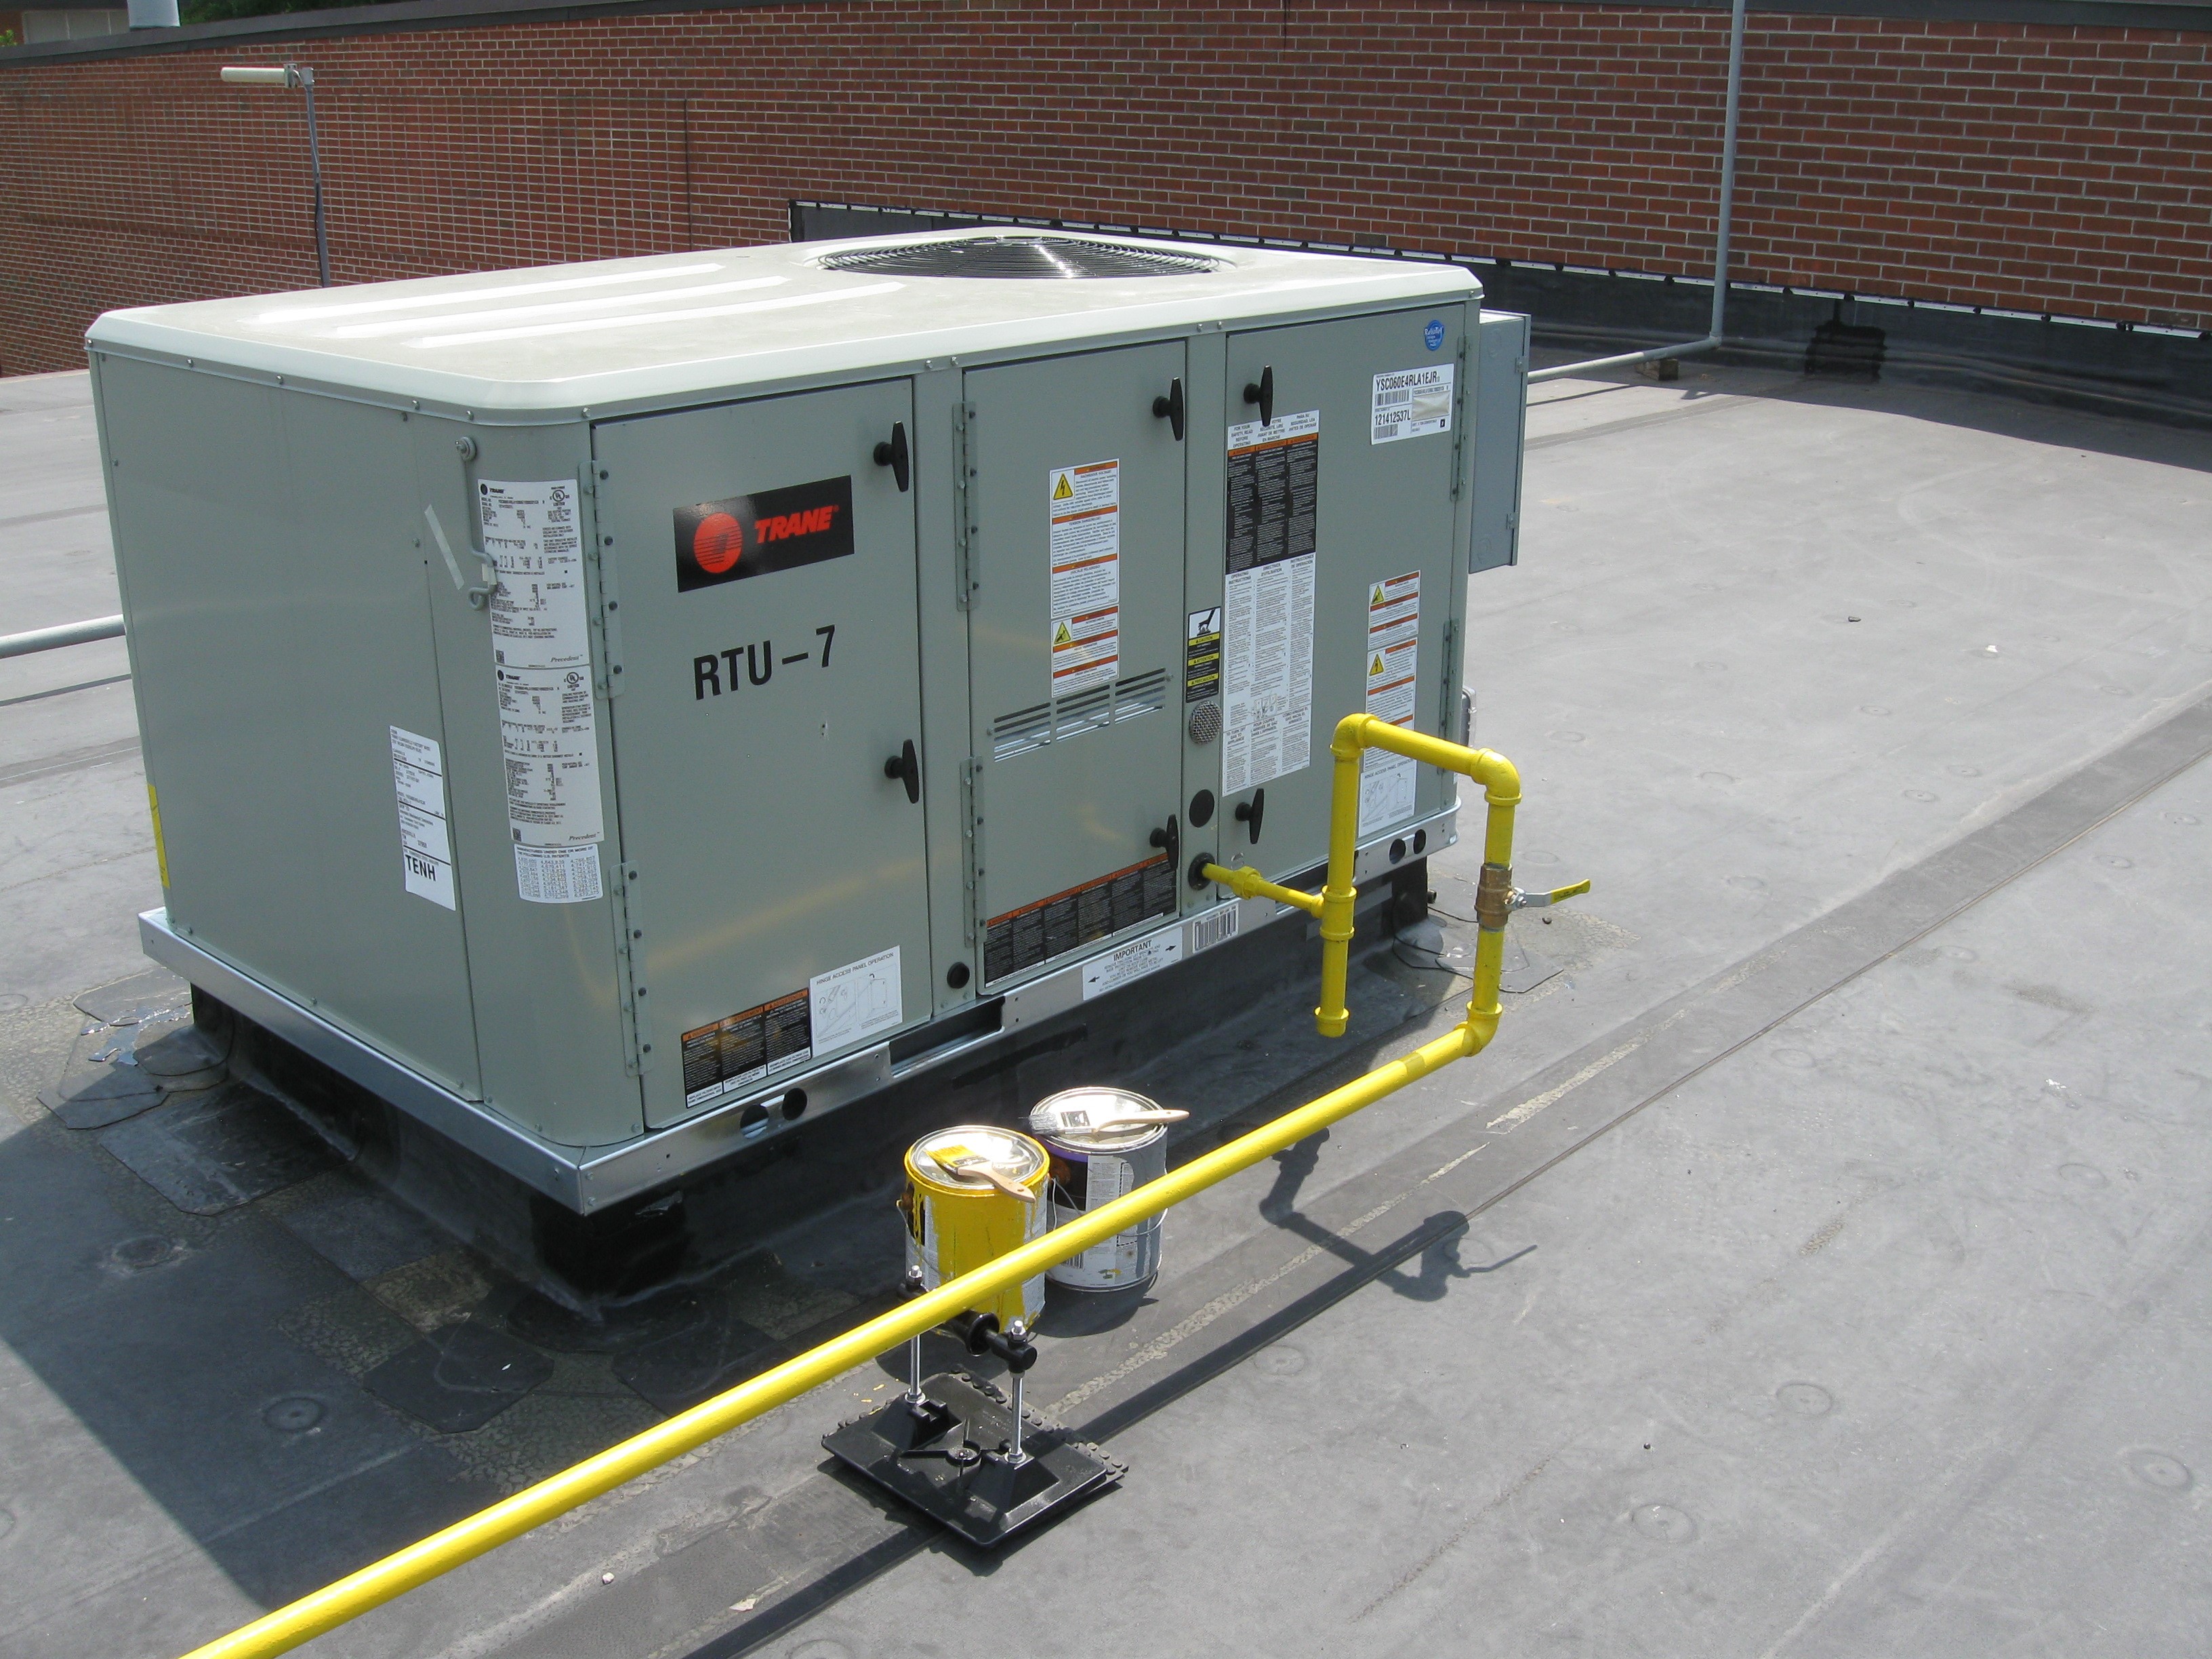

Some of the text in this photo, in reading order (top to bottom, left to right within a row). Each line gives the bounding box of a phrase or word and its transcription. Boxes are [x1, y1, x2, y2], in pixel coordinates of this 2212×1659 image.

[1374, 409, 1411, 426] 121412537L
[405, 854, 436, 882] TENH
[867, 952, 894, 966] OPERATION
[1113, 940, 1151, 961] IMPORTANT
